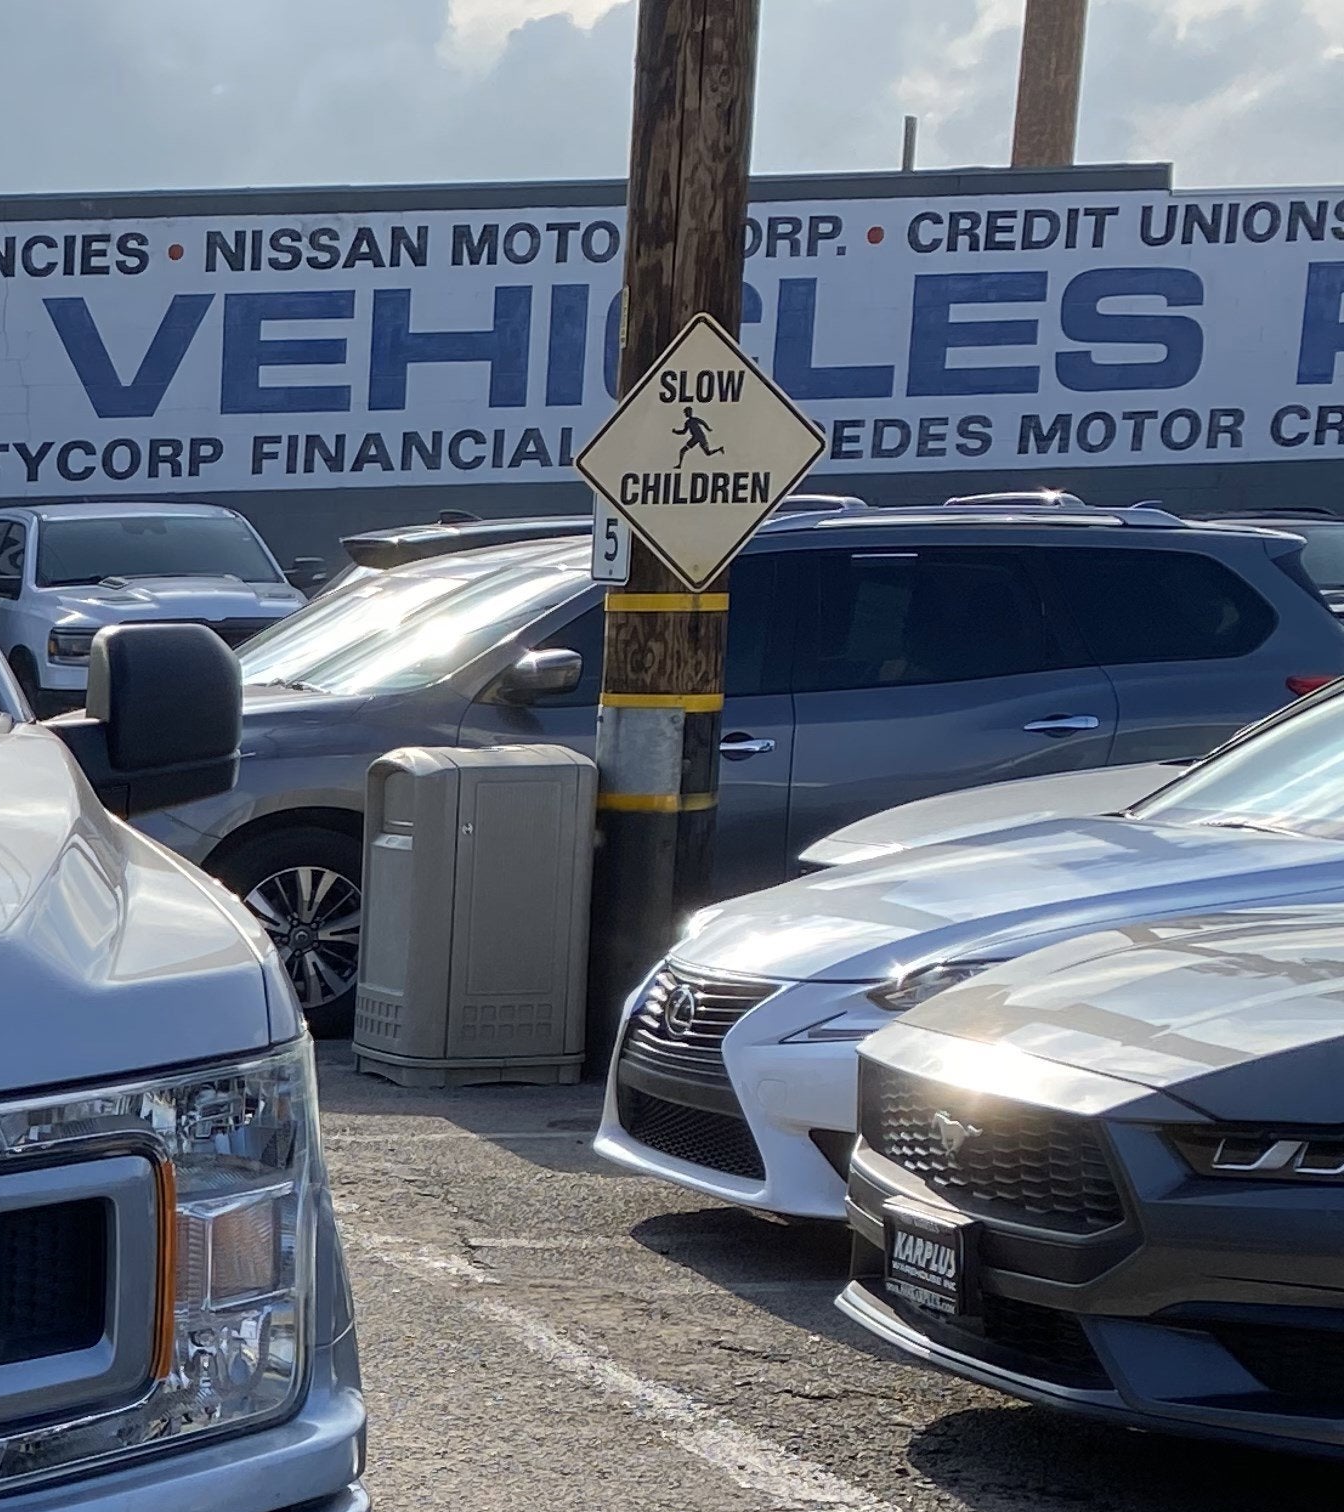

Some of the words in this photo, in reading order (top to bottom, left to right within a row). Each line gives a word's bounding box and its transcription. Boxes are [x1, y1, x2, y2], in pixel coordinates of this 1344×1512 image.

[204, 224, 429, 272] NISSAN
[907, 205, 1120, 254] CREDIT
[658, 369, 745, 403] SLOW
[250, 426, 575, 475] FINANCIAL
[812, 414, 994, 460] EDES
[1016, 407, 1247, 456] MOTOR
[620, 471, 772, 506] CHILDREN
[604, 517, 619, 562] 5
[893, 1231, 957, 1279] KARPLUS
